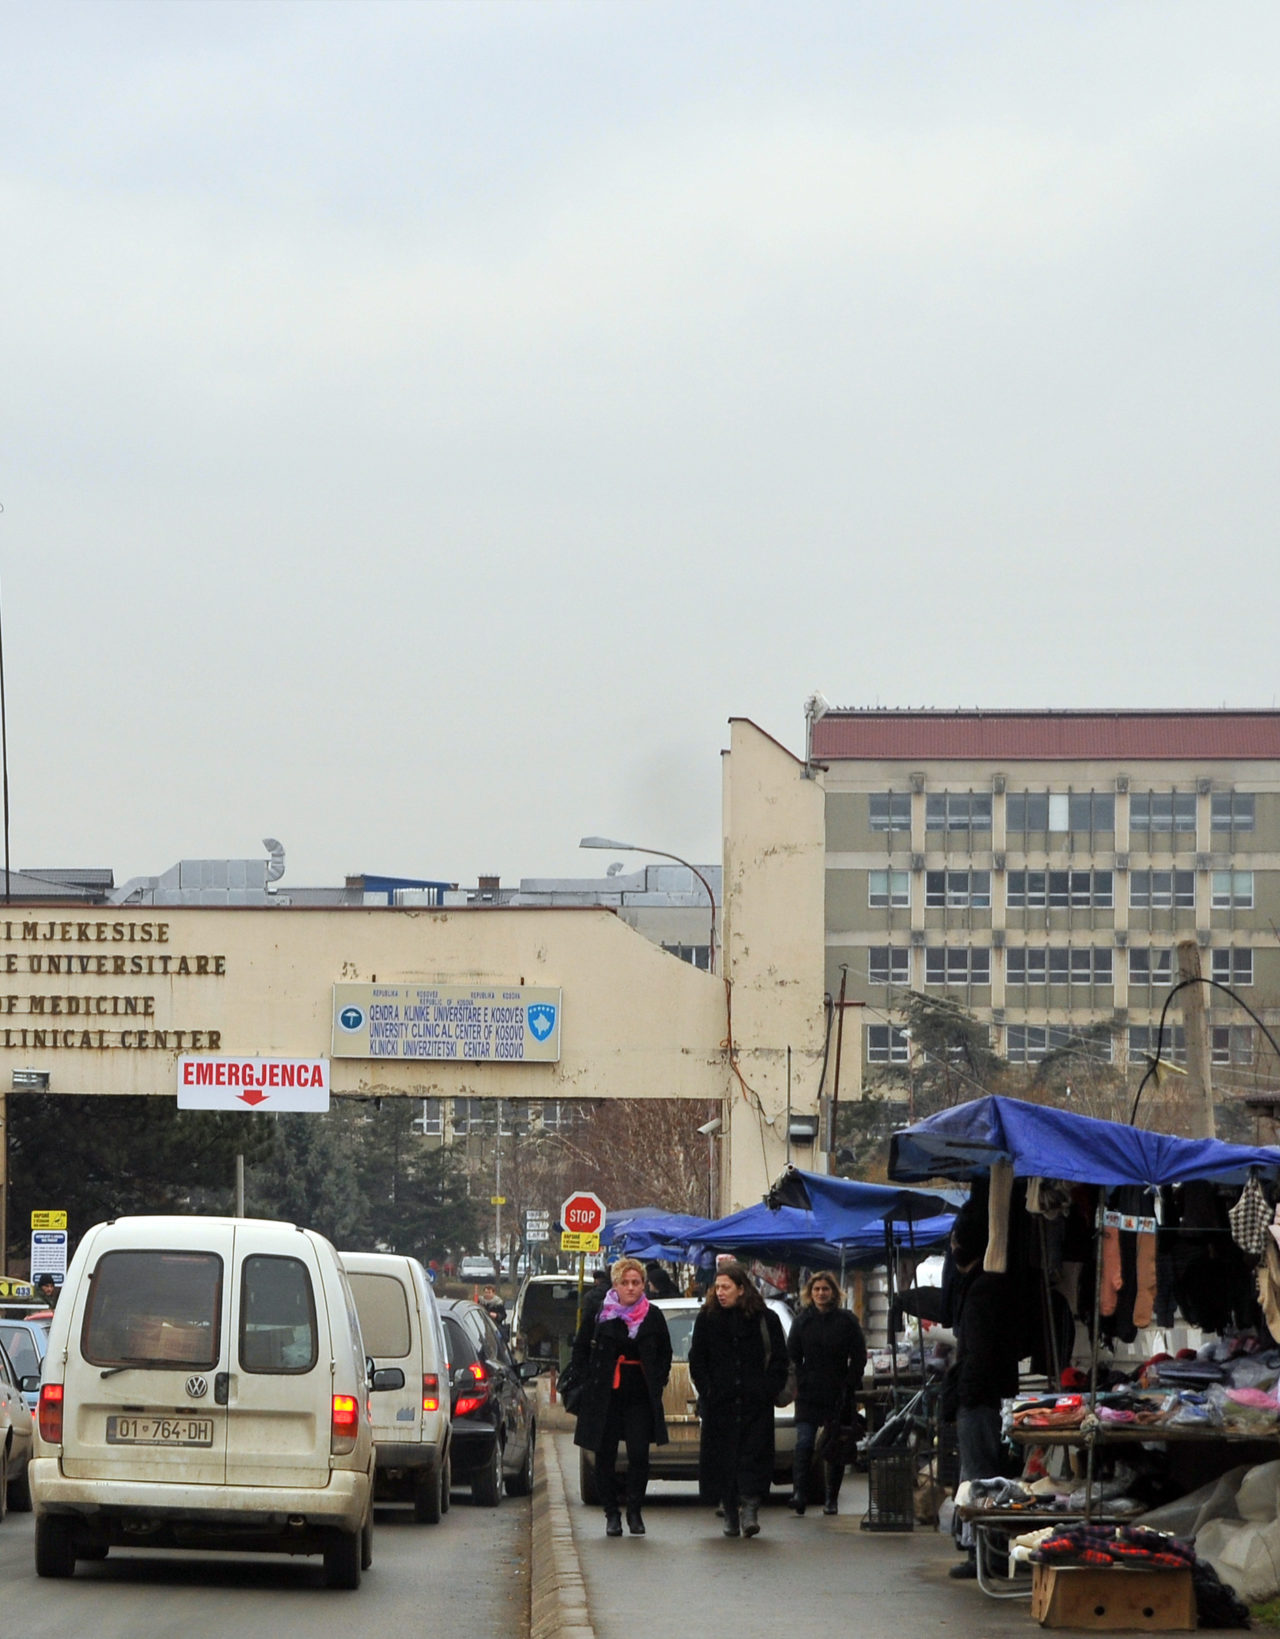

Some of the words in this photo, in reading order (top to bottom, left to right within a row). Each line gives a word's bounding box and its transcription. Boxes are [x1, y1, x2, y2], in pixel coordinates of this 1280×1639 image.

[22, 921, 169, 943] MJEKESISE
[28, 954, 226, 976] UNIVERSITARE
[30, 995, 155, 1017] MEDICINE
[369, 1005, 399, 1021] QENDRA
[404, 1006, 430, 1022] KLINIKE
[434, 1006, 482, 1023] UNIVERSITARE
[484, 1007, 488, 1023] E
[121, 1030, 221, 1050] CENTER
[370, 1022, 408, 1038] UNIVERSITY
[412, 1023, 452, 1038] CLINICAL
[455, 1024, 481, 1040] CENTER
[484, 1025, 492, 1040] OF
[495, 1025, 524, 1041] KOSOVO
[403, 1040, 457, 1057] UNIVERZITETSKI
[464, 1041, 490, 1057] CENTAR
[495, 1042, 524, 1058] KOSOVO
[183, 1062, 323, 1087] EMERGJENCA
[569, 1209, 596, 1224] STOP
[16, 1287, 31, 1296] 433
